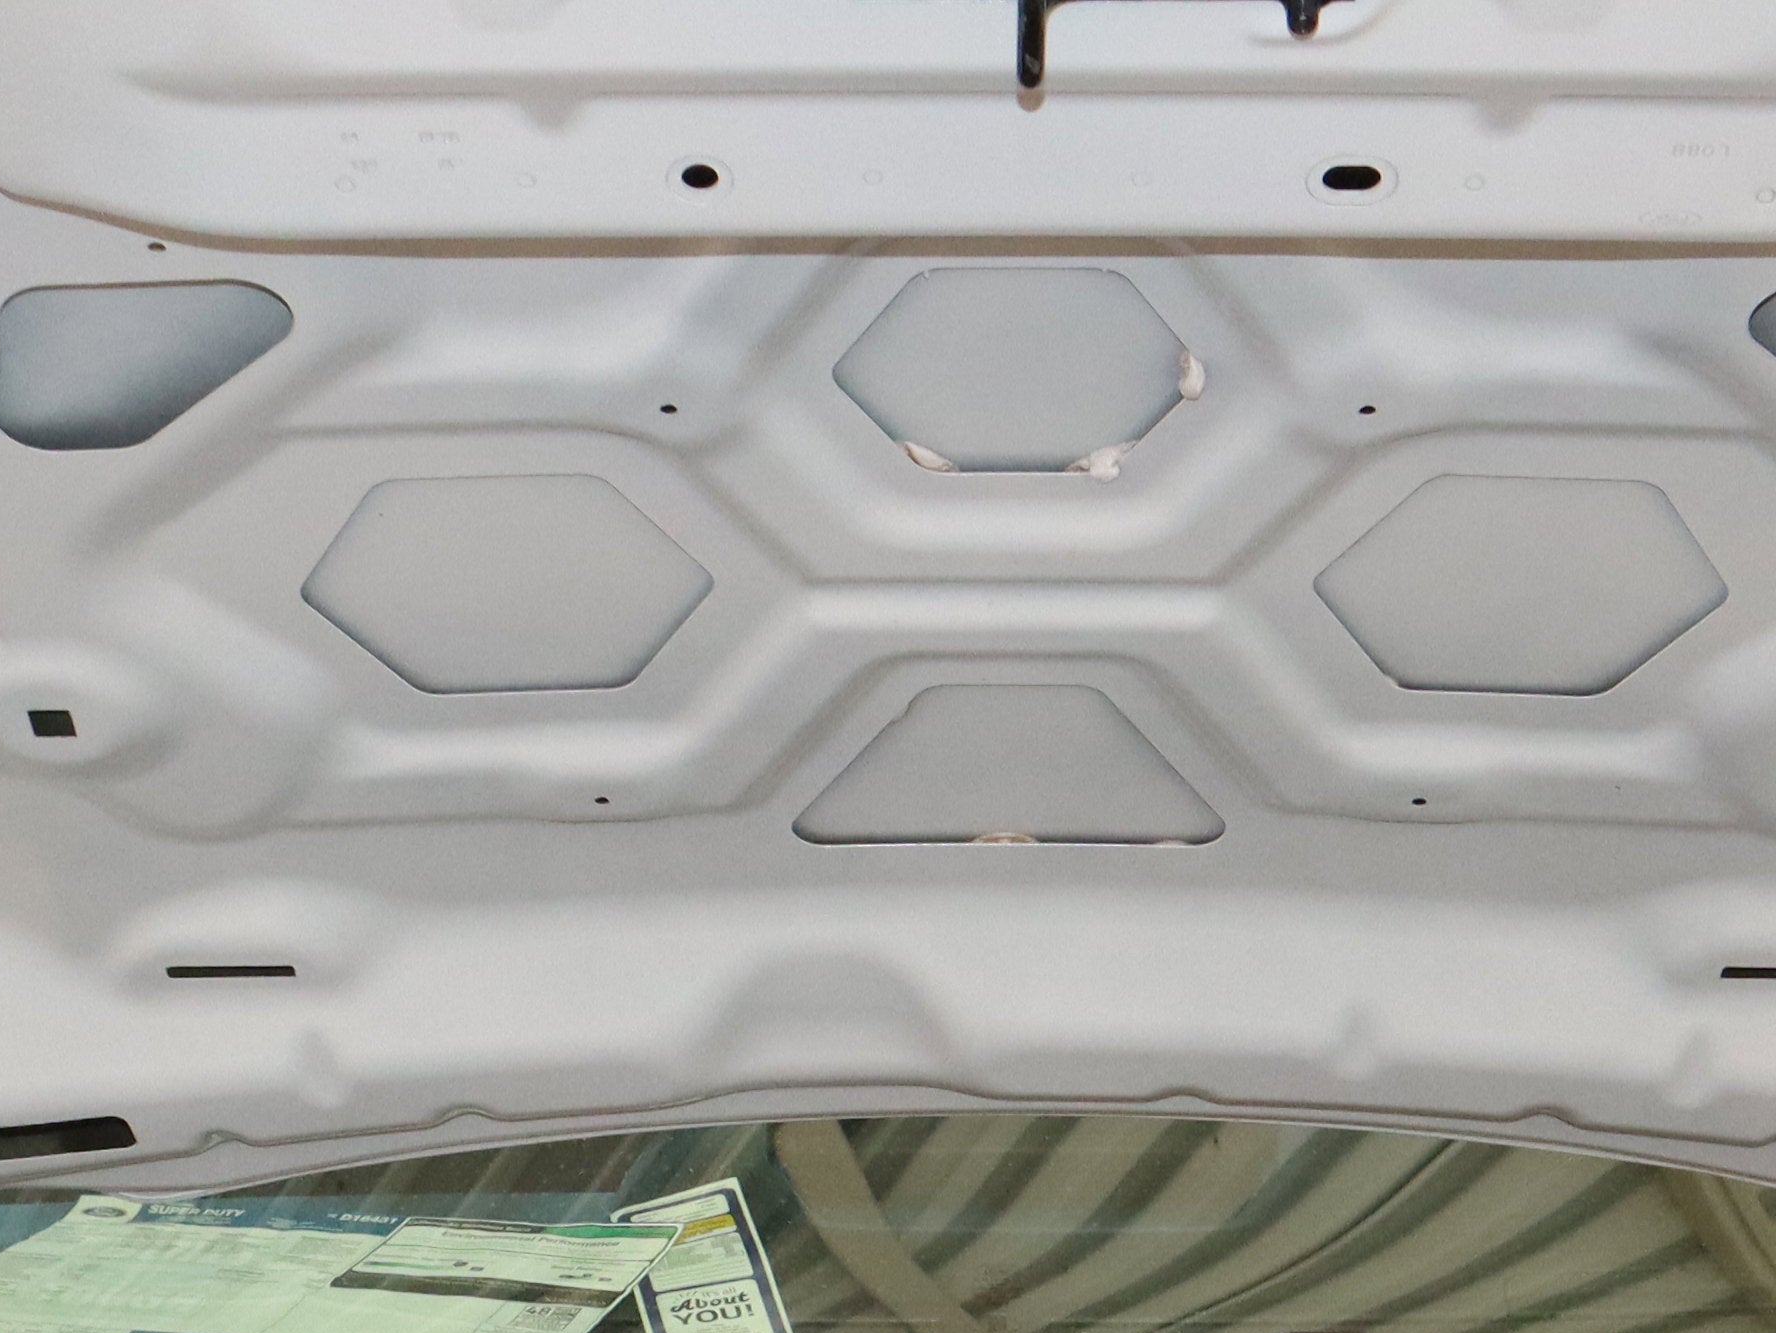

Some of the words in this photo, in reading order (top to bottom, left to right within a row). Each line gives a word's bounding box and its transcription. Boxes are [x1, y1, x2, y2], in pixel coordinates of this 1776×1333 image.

[148, 1204, 201, 1216] SUPER
[670, 1291, 750, 1312] About
[672, 1303, 754, 1325] YOU!
